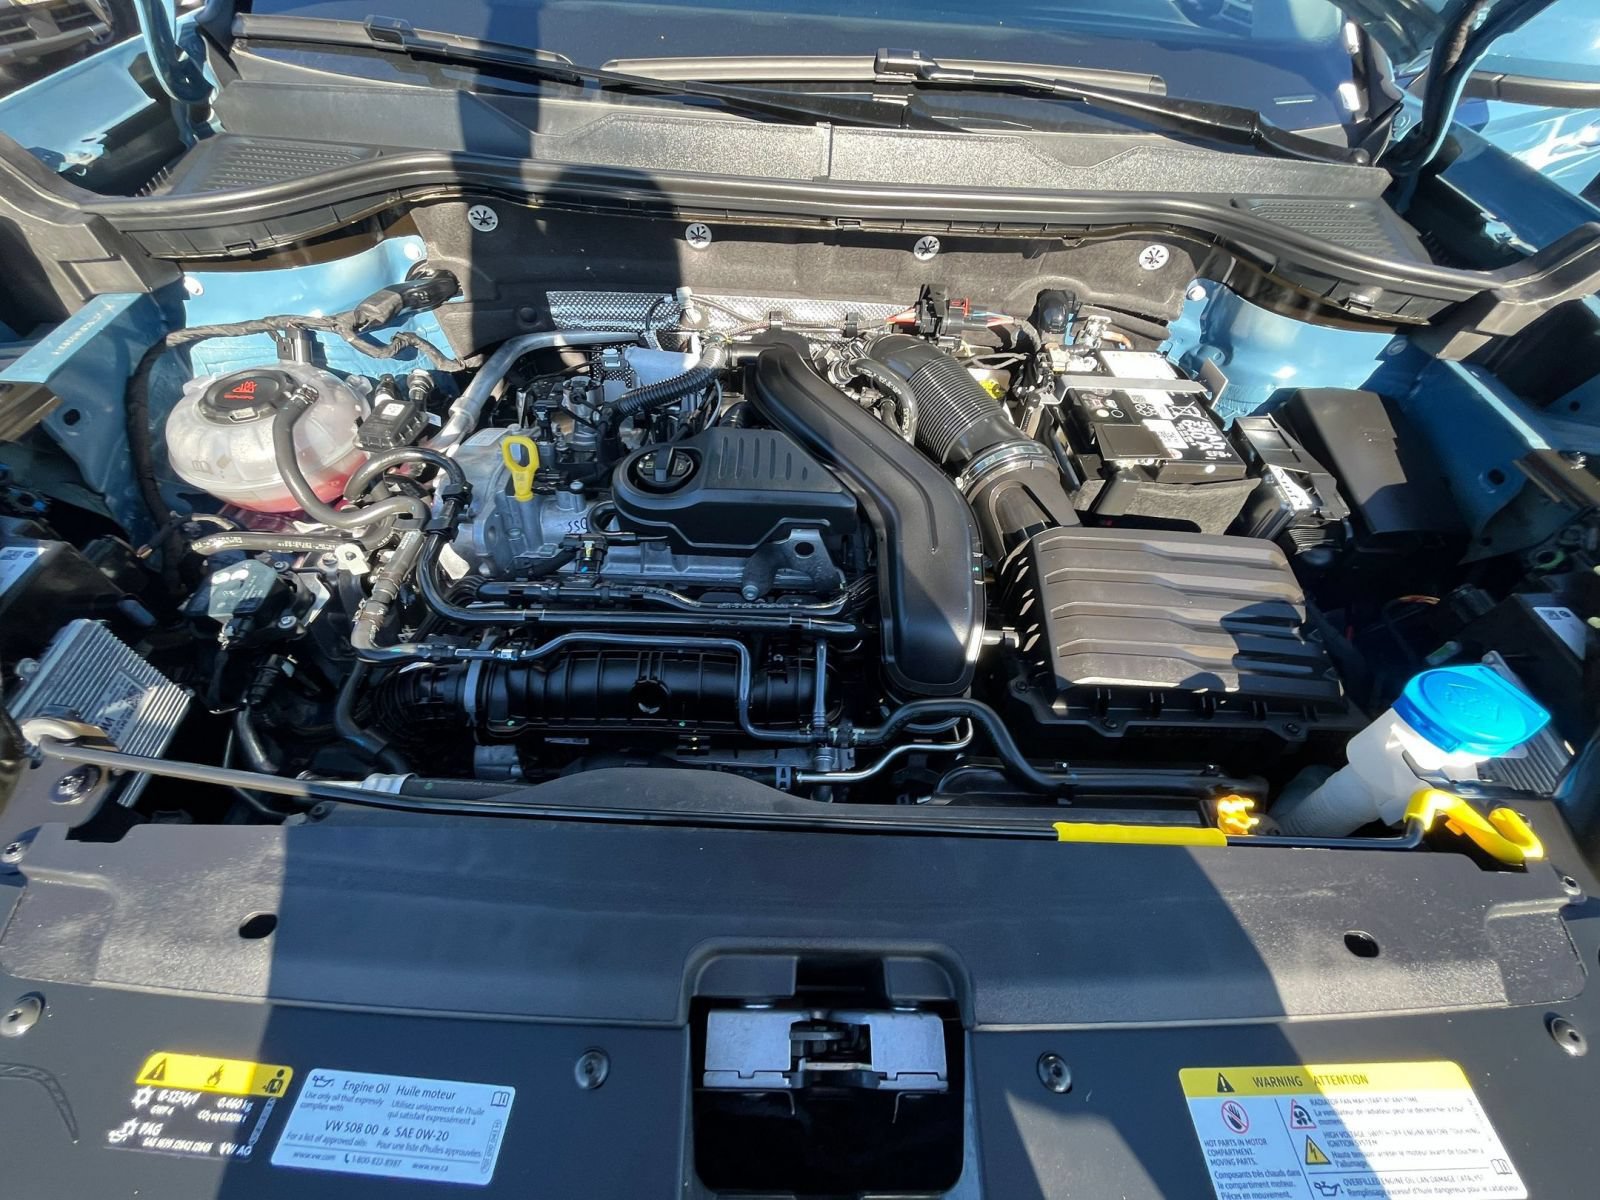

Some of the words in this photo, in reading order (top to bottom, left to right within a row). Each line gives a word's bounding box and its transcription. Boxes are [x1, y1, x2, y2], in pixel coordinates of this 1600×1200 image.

[1253, 1076, 1303, 1087] WARNING
[1312, 1074, 1369, 1085] ATTENTION
[342, 1080, 374, 1094] Engine
[375, 1083, 389, 1093] Oil
[396, 1086, 421, 1096] Huile
[422, 1089, 456, 1099] moteur
[299, 1101, 328, 1111] complies
[415, 1103, 454, 1114] uniquement
[387, 1111, 398, 1119] qui
[399, 1112, 425, 1120] satisfait
[138, 1123, 164, 1136] PAG
[324, 1120, 344, 1131] VW
[343, 1122, 363, 1133] 508
[364, 1124, 379, 1134] 00
[395, 1126, 414, 1138] SAE
[415, 1129, 449, 1141] 0W-20
[322, 1135, 354, 1146] approved
[219, 1142, 237, 1155] VW
[236, 1145, 252, 1156] AG
[405, 1143, 419, 1151] liste
[1214, 1170, 1252, 1180] Composants
[1265, 1169, 1285, 1177] chauds
[1225, 1180, 1269, 1189] compartiment
[1220, 1191, 1240, 1199] Pièces
